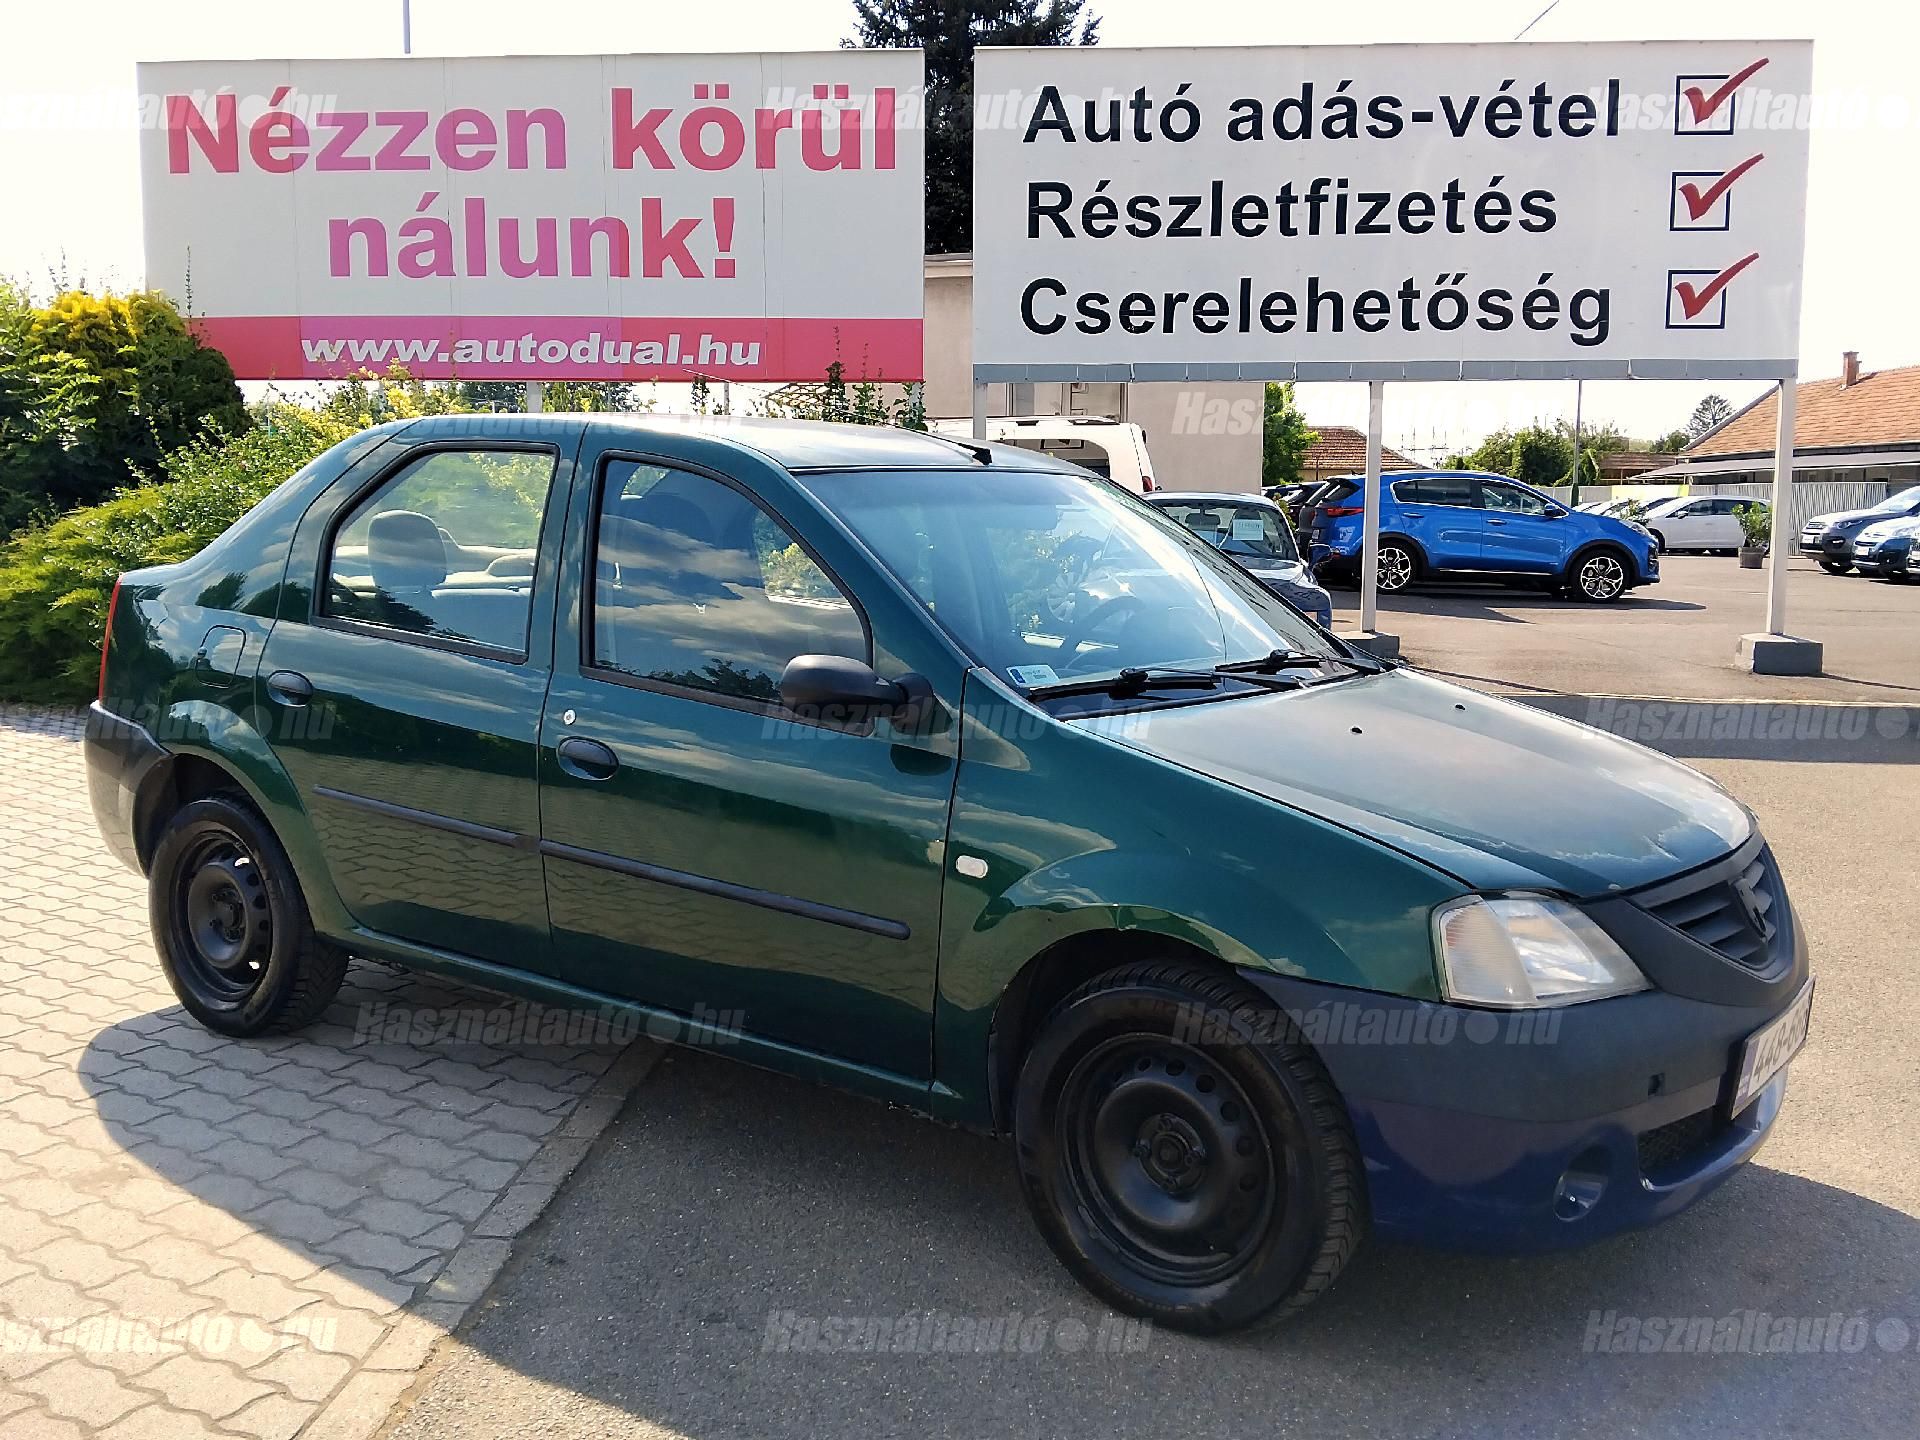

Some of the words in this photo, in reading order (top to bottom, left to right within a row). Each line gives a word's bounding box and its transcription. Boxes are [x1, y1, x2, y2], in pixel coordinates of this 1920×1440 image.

[165, 86, 567, 174] Nézzen
[611, 83, 897, 172] körül
[1022, 80, 1201, 145] Autó
[1226, 76, 1621, 142] adás-vétel
[328, 190, 737, 279] nálunk!
[1027, 175, 1559, 240] Részletfizetés
[1019, 271, 1612, 346] Cserelehetőség
[301, 332, 761, 366] www.autodual.hu
